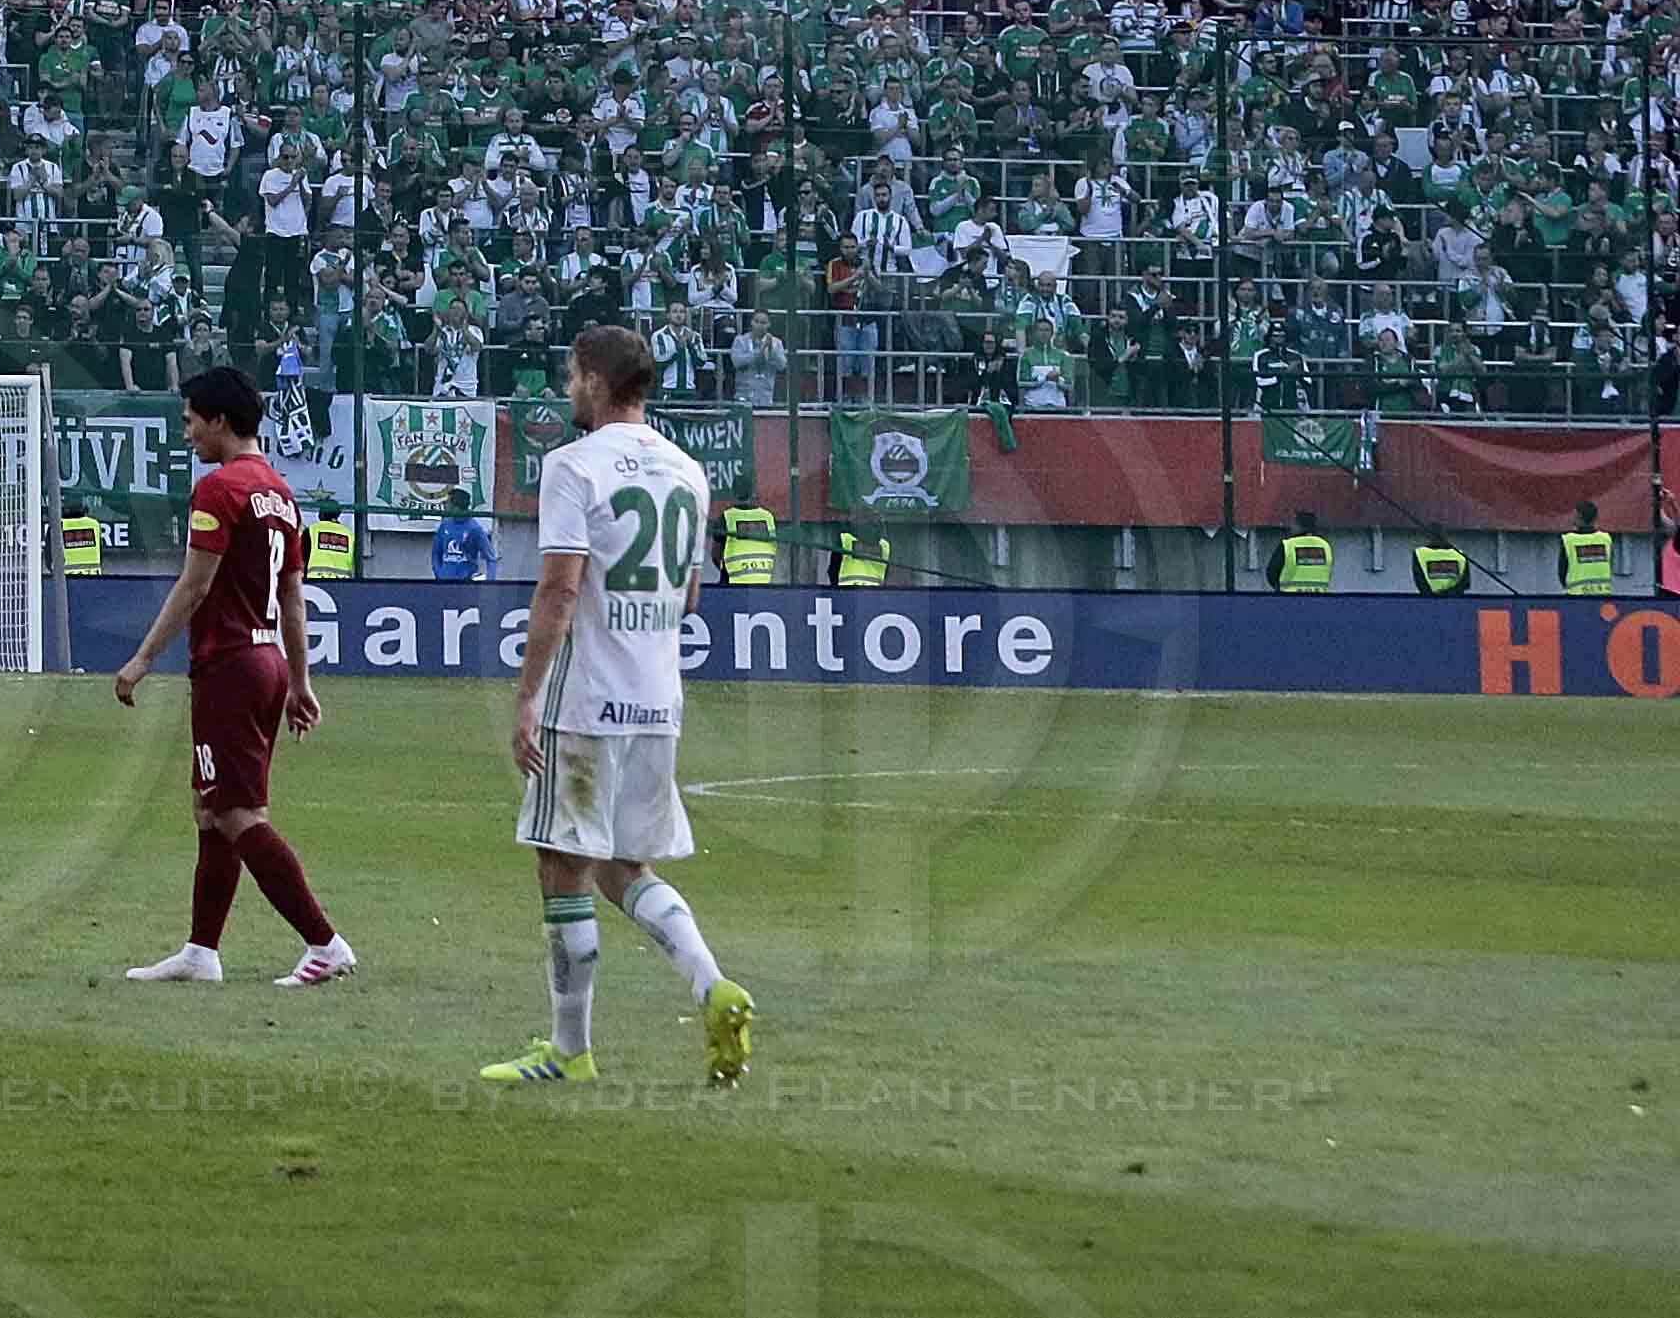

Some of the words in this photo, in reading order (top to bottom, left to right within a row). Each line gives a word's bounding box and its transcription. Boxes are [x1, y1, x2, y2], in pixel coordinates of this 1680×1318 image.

[396, 432, 426, 448] FAN
[606, 485, 700, 591] 20
[599, 699, 670, 726] Allianz
[196, 743, 216, 781] 18
